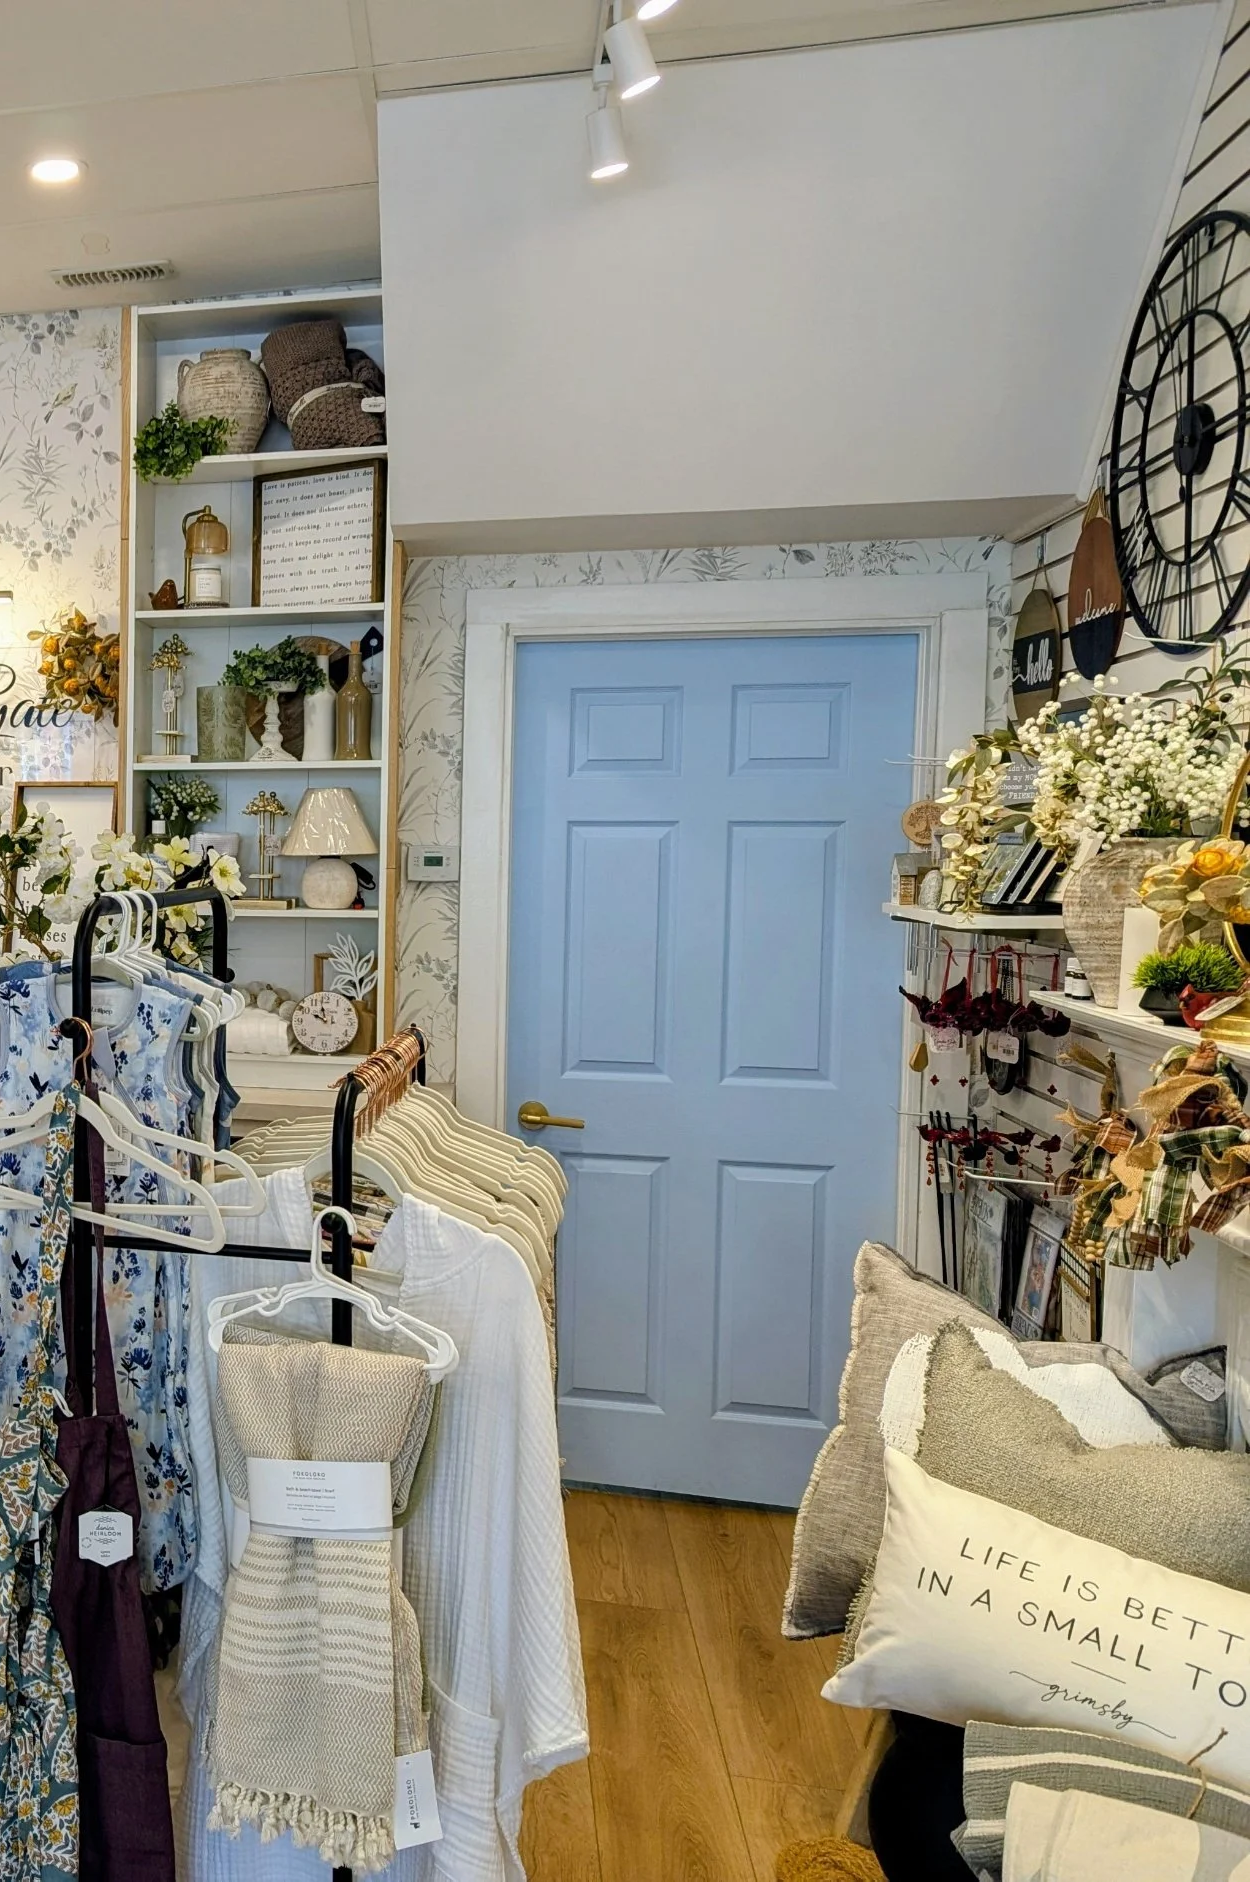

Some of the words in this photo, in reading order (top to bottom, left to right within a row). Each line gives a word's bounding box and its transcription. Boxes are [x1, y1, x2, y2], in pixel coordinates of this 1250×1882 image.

[1012, 638, 1053, 685] hello
[961, 1537, 1040, 1582] LIFE
[1063, 1575, 1099, 1601] IS
[1124, 1597, 1245, 1654] BETT
[918, 1567, 953, 1596] IN
[970, 1589, 992, 1612] A
[1018, 1602, 1151, 1671] SMALL
[1185, 1663, 1246, 1707] TO
[406, 1780, 415, 1820] POKOLOKO
